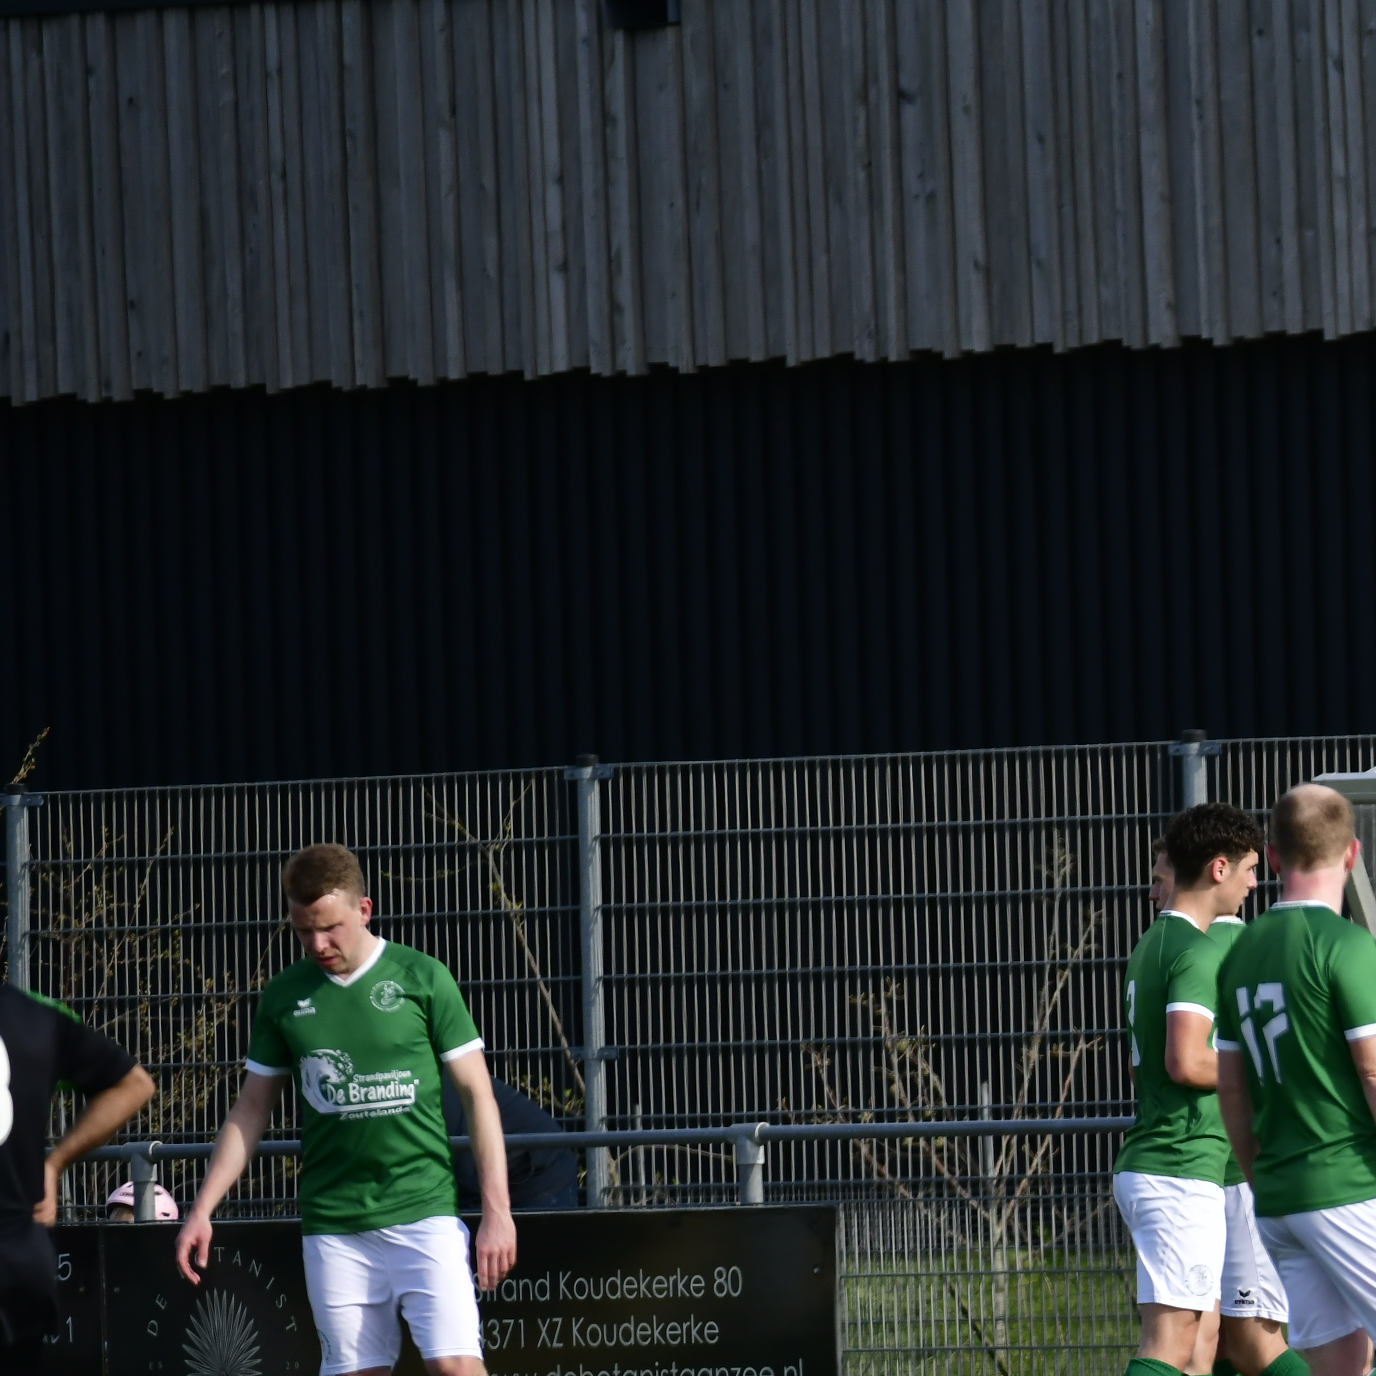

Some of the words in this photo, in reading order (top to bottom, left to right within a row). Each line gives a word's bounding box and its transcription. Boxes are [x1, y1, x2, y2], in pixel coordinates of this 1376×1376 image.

[1236, 982, 1289, 1087] 17
[179, 1246, 298, 1333] TANIST
[473, 1271, 550, 1303] Srand
[559, 1267, 706, 1301] Koudekerke
[713, 1266, 743, 1298] 80
[537, 1317, 564, 1348] XZ
[572, 1314, 720, 1347] Koudekerke
